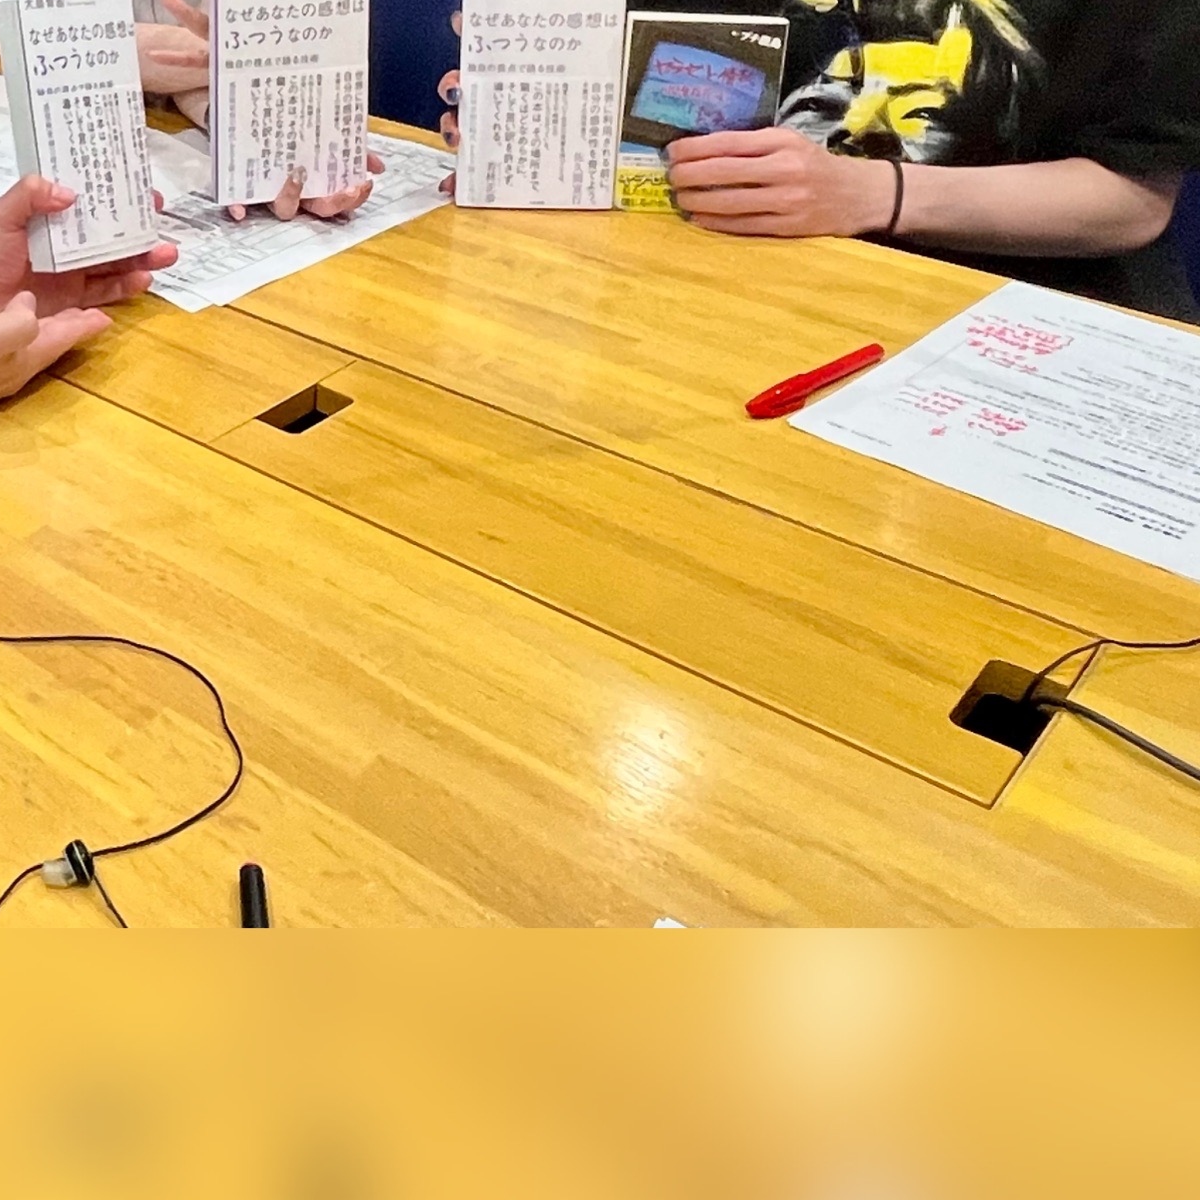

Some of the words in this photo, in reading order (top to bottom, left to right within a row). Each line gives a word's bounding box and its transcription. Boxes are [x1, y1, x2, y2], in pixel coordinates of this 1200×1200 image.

[225, 0, 365, 23] なぜあなたの感想は
[470, 12, 618, 29] なぜあなたの感想は
[225, 25, 333, 49] ふつうなのか
[468, 33, 581, 53] ふつうなのか
[34, 47, 120, 76] ふつうなのか
